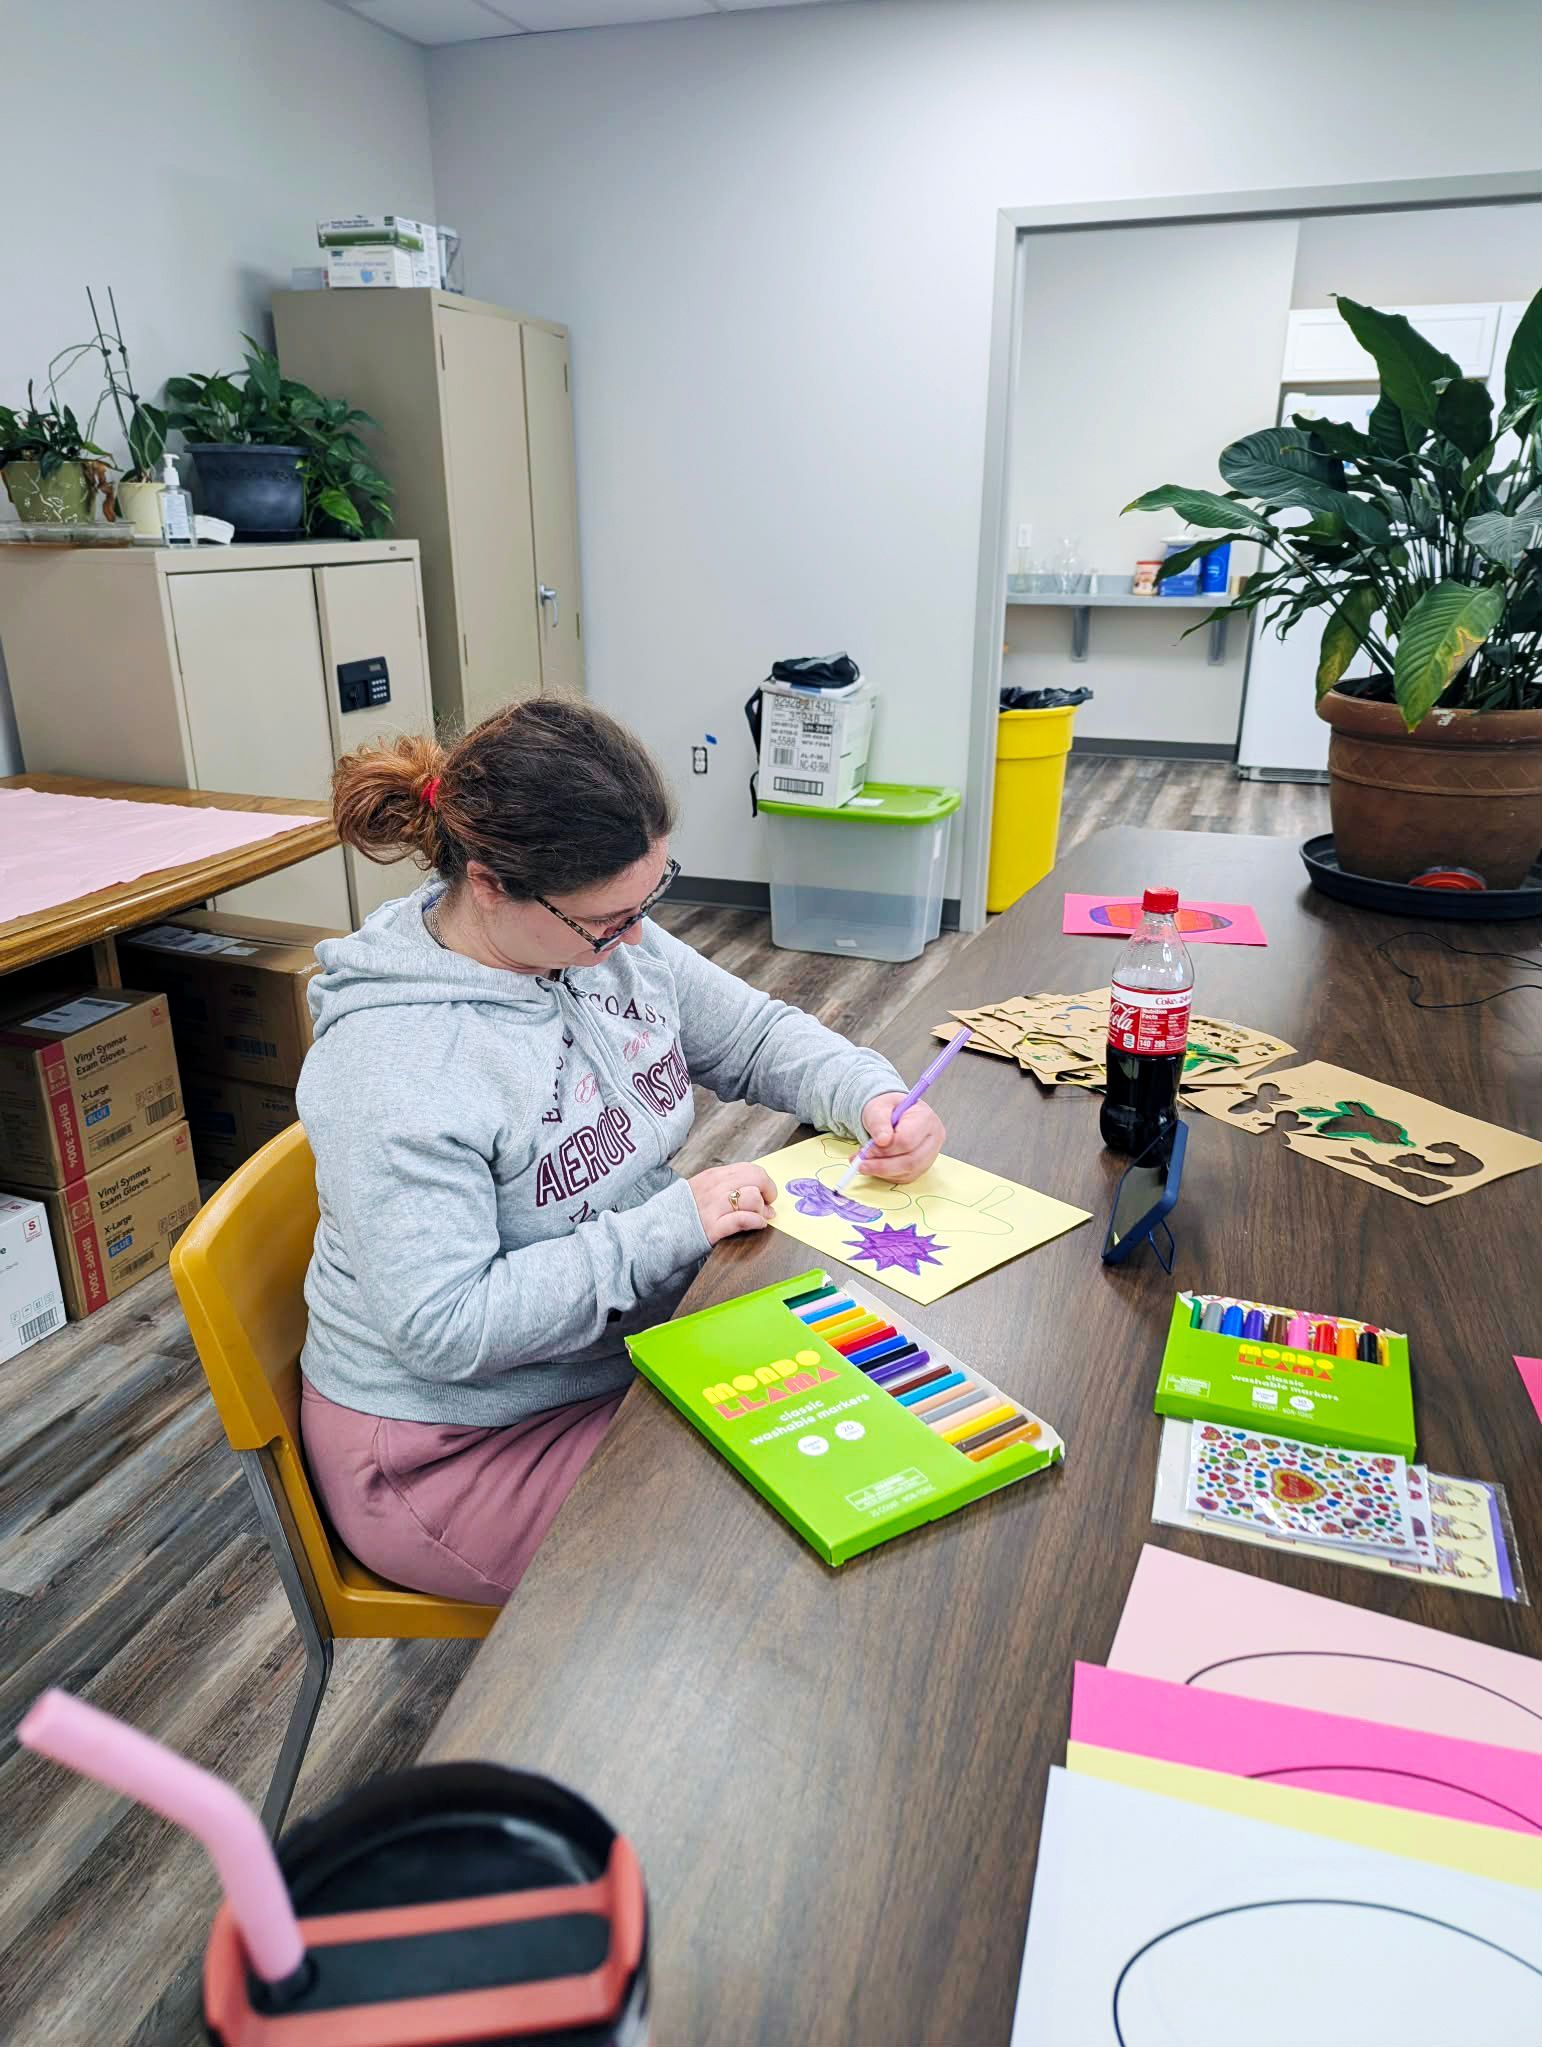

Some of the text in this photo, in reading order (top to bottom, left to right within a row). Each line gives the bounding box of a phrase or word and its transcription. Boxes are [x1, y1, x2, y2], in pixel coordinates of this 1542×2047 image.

[74, 1048, 96, 1064] Vinyl
[76, 1061, 98, 1076] Exam
[99, 1048, 125, 1064] Gloves
[81, 1084, 109, 1103] X-Large
[87, 1106, 108, 1125] BLUE
[58, 1103, 79, 1168] BMPF 3004
[97, 1183, 119, 1198] Vinyl
[120, 1166, 152, 1186] Synmax
[100, 1178, 149, 1210] Exam Gloves
[28, 1220, 37, 1231] S
[104, 1214, 133, 1235] X-Large
[110, 1236, 131, 1256] BLUE
[81, 1236, 99, 1298] BMPF 3004
[1231, 1375, 1288, 1391] washable
[1290, 1386, 1340, 1402] markers
[1265, 1374, 1305, 1387] classic
[750, 1393, 871, 1446] washable markers
[780, 1399, 824, 1422] classic
